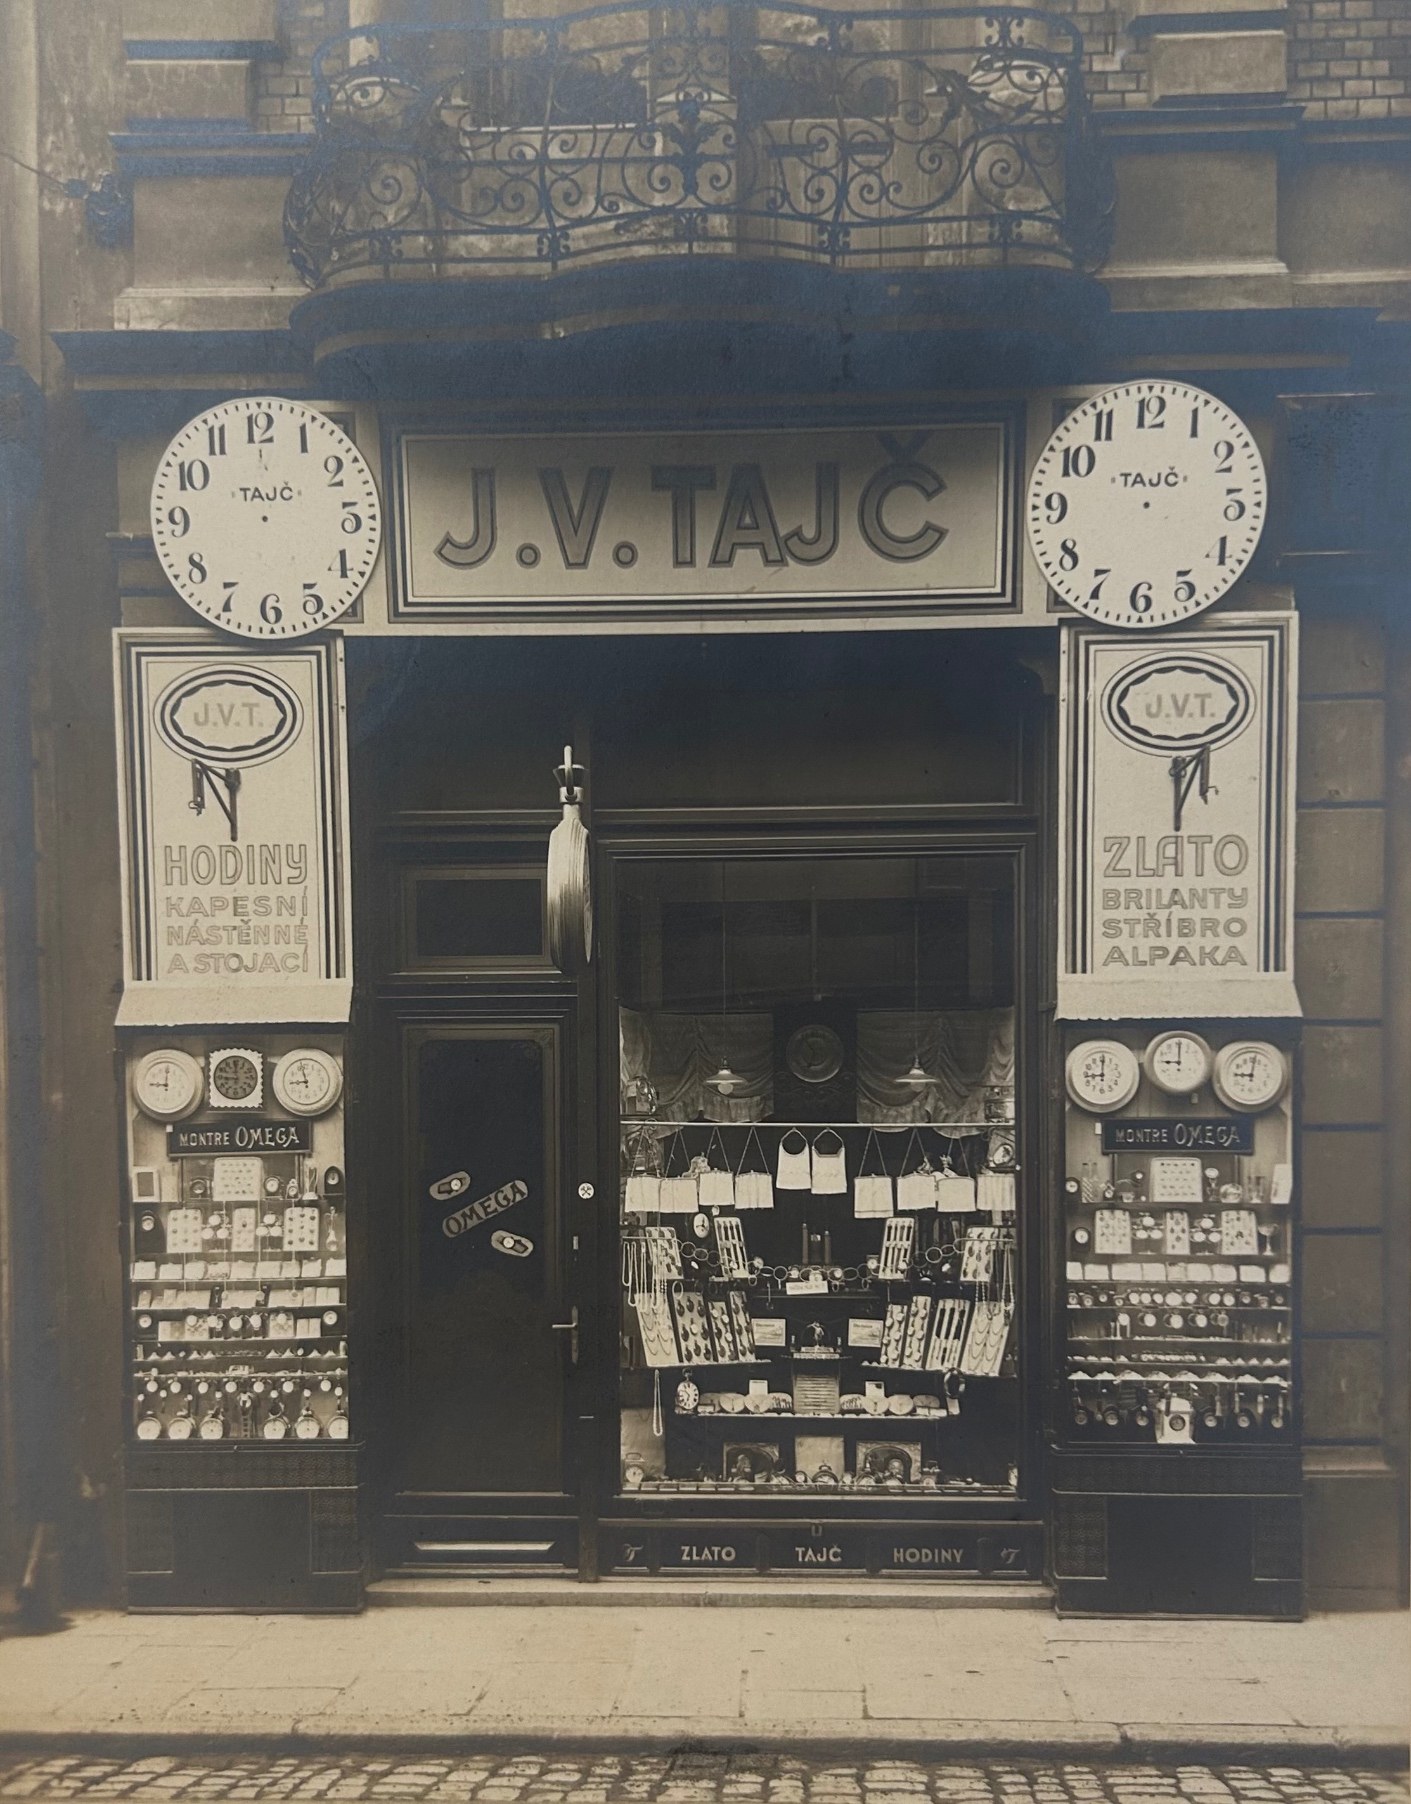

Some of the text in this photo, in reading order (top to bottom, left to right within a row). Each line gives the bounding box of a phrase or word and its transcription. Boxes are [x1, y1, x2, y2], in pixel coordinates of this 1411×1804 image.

[247, 412, 274, 444] 12
[1094, 408, 1113, 441] 11
[1135, 395, 1166, 429] 12
[1190, 407, 1198, 438] 1
[208, 424, 227, 456] 11
[300, 423, 308, 453] 1
[324, 455, 344, 487] 2
[1060, 444, 1095, 478] 10
[1214, 440, 1234, 473] 2
[178, 459, 210, 491] 10
[1119, 466, 1179, 487] TAJČ
[239, 481, 293, 502] TAJČ
[651, 431, 949, 569] TAJČ
[168, 506, 190, 538] 9
[1045, 492, 1068, 524] 9
[328, 549, 353, 579] 4
[1059, 538, 1079, 571] 8
[1204, 535, 1232, 566] 4
[188, 552, 207, 584] 8
[1089, 568, 1111, 600] 7
[222, 582, 239, 612] 7
[303, 582, 324, 615] 5
[1129, 582, 1152, 613] 6
[1174, 569, 1196, 602] 5
[260, 594, 282, 624] 6
[194, 702, 264, 727] J.V.T.
[1145, 693, 1216, 719] J.V.T.
[163, 844, 308, 886] HODINY
[1103, 835, 1248, 877] ZLATO
[166, 886, 308, 918] KAPESNÍ
[1102, 888, 1248, 910] BRILANTY
[167, 917, 308, 946] NÁSTĚNNÉ
[1102, 911, 1247, 938] STŘÍBRO
[168, 946, 308, 974] A STOJACÍ
[1102, 946, 1247, 966] ALPAKA
[180, 1125, 300, 1148] MONTRE OMEGA
[1116, 1123, 1240, 1147] MONTRE OMEGA
[445, 1181, 527, 1236] OMEGA
[681, 1546, 736, 1562] ZLATO
[795, 1544, 842, 1562] TAJČ
[893, 1547, 964, 1564] HODINY
